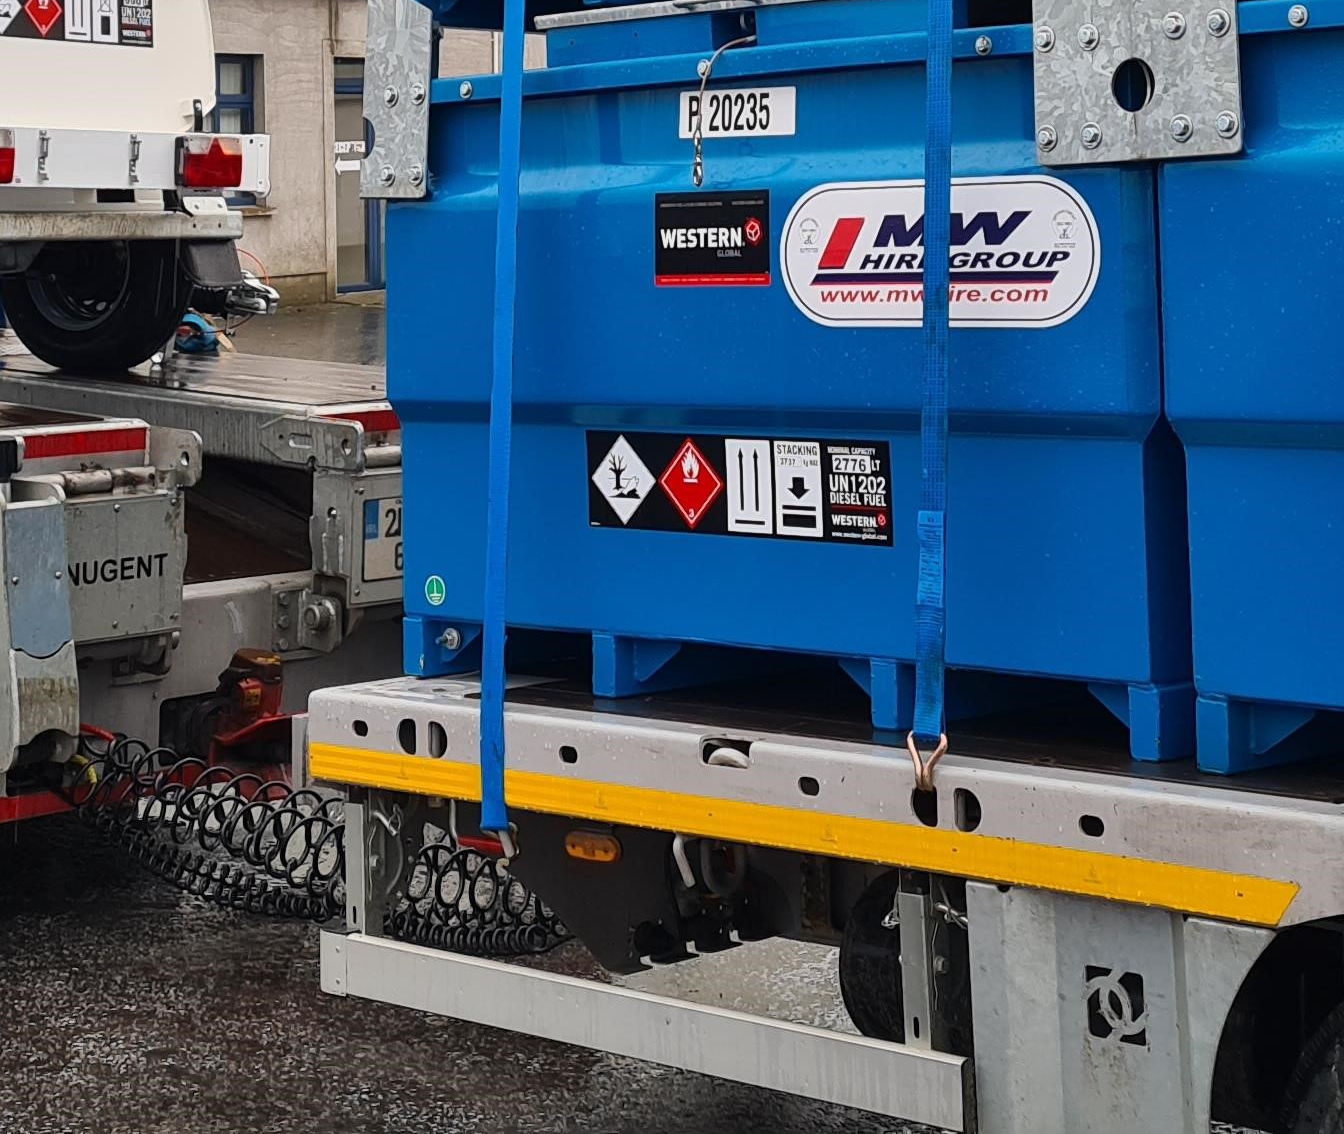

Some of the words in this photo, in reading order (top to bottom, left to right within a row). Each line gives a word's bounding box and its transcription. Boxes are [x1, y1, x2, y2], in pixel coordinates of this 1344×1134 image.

[688, 95, 700, 132] P
[709, 92, 770, 131] 20235
[873, 210, 1033, 247] MW
[660, 226, 743, 248] WESTERN
[717, 249, 742, 257] GLOBAL
[949, 250, 1070, 270] GROUP
[777, 444, 818, 456] STACKING
[851, 447, 876, 455] CAPACITY
[833, 457, 867, 472] 2776
[870, 460, 881, 472] LT
[829, 475, 886, 495] UN1202
[830, 492, 862, 506] DIESEL
[864, 494, 887, 507] FUEL
[688, 508, 695, 519] 3
[831, 514, 878, 528] WESTERN
[67, 552, 168, 587] NUGENT
